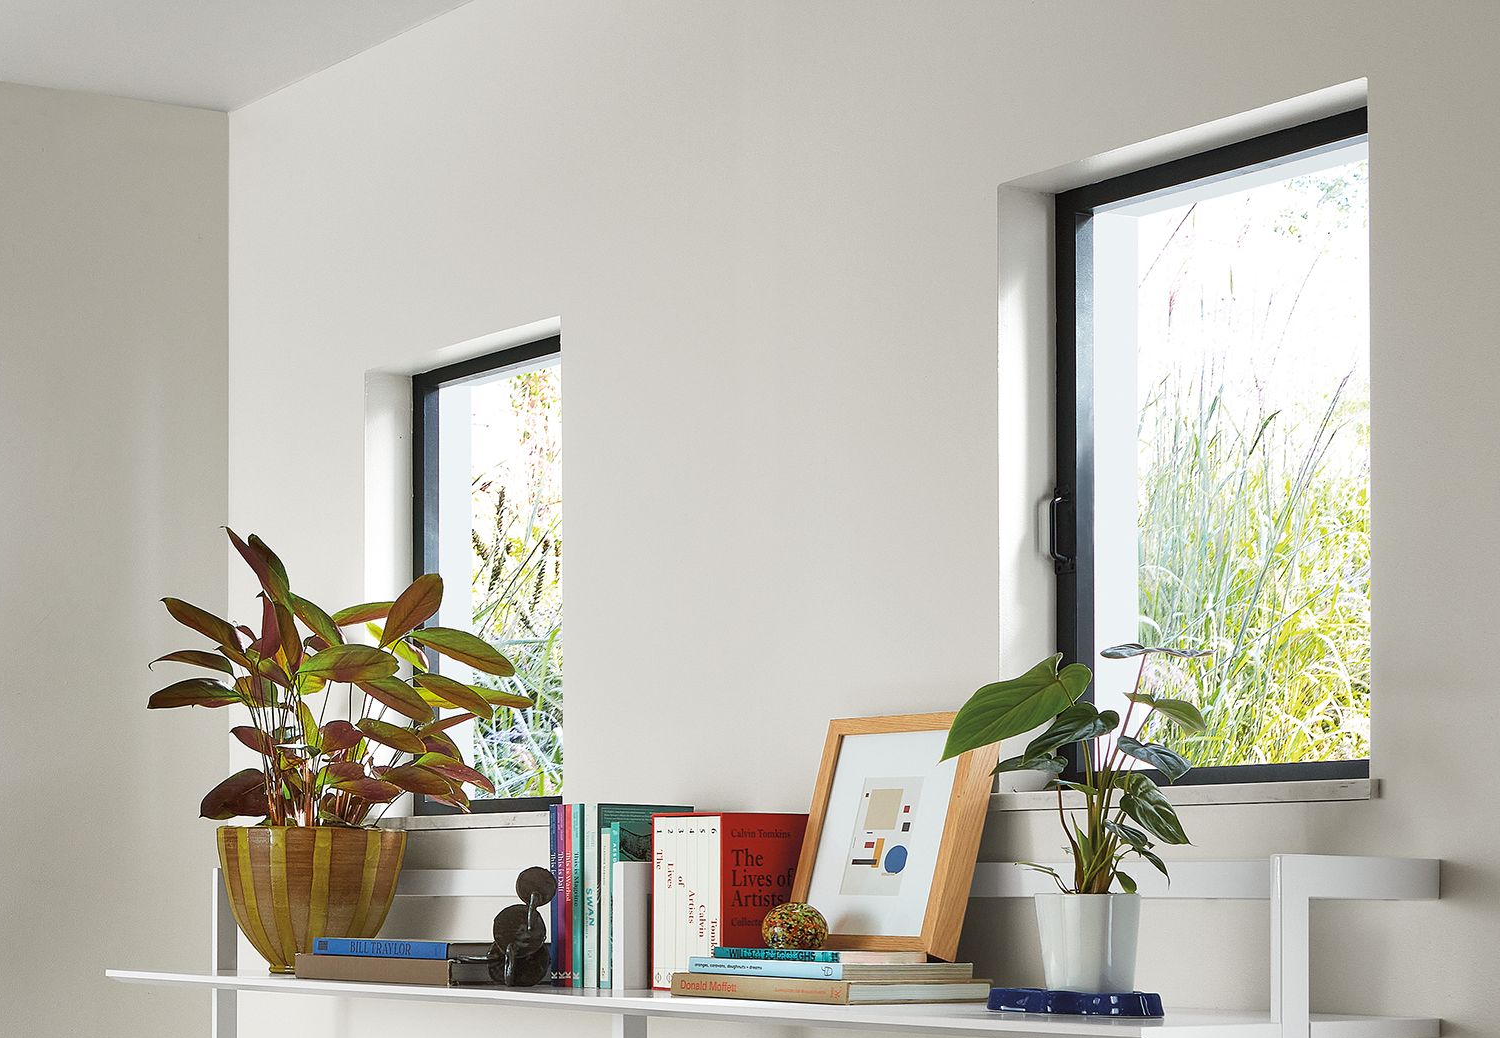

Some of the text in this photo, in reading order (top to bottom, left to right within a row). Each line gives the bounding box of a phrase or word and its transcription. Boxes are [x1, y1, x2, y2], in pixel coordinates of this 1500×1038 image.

[730, 828, 791, 839] Calvin Tomkins
[656, 849, 664, 870] The
[731, 848, 764, 867] The
[678, 875, 685, 888] of
[731, 868, 795, 887] Lives of
[585, 887, 595, 927] SWAN
[688, 890, 696, 924] Artists
[731, 890, 784, 907] Artists
[698, 904, 706, 938] Calvin
[731, 916, 763, 927] Collecte
[710, 918, 719, 957] Tomk
[350, 941, 411, 956] BILL TRAYLOR
[680, 980, 737, 993] Donald Moffett
